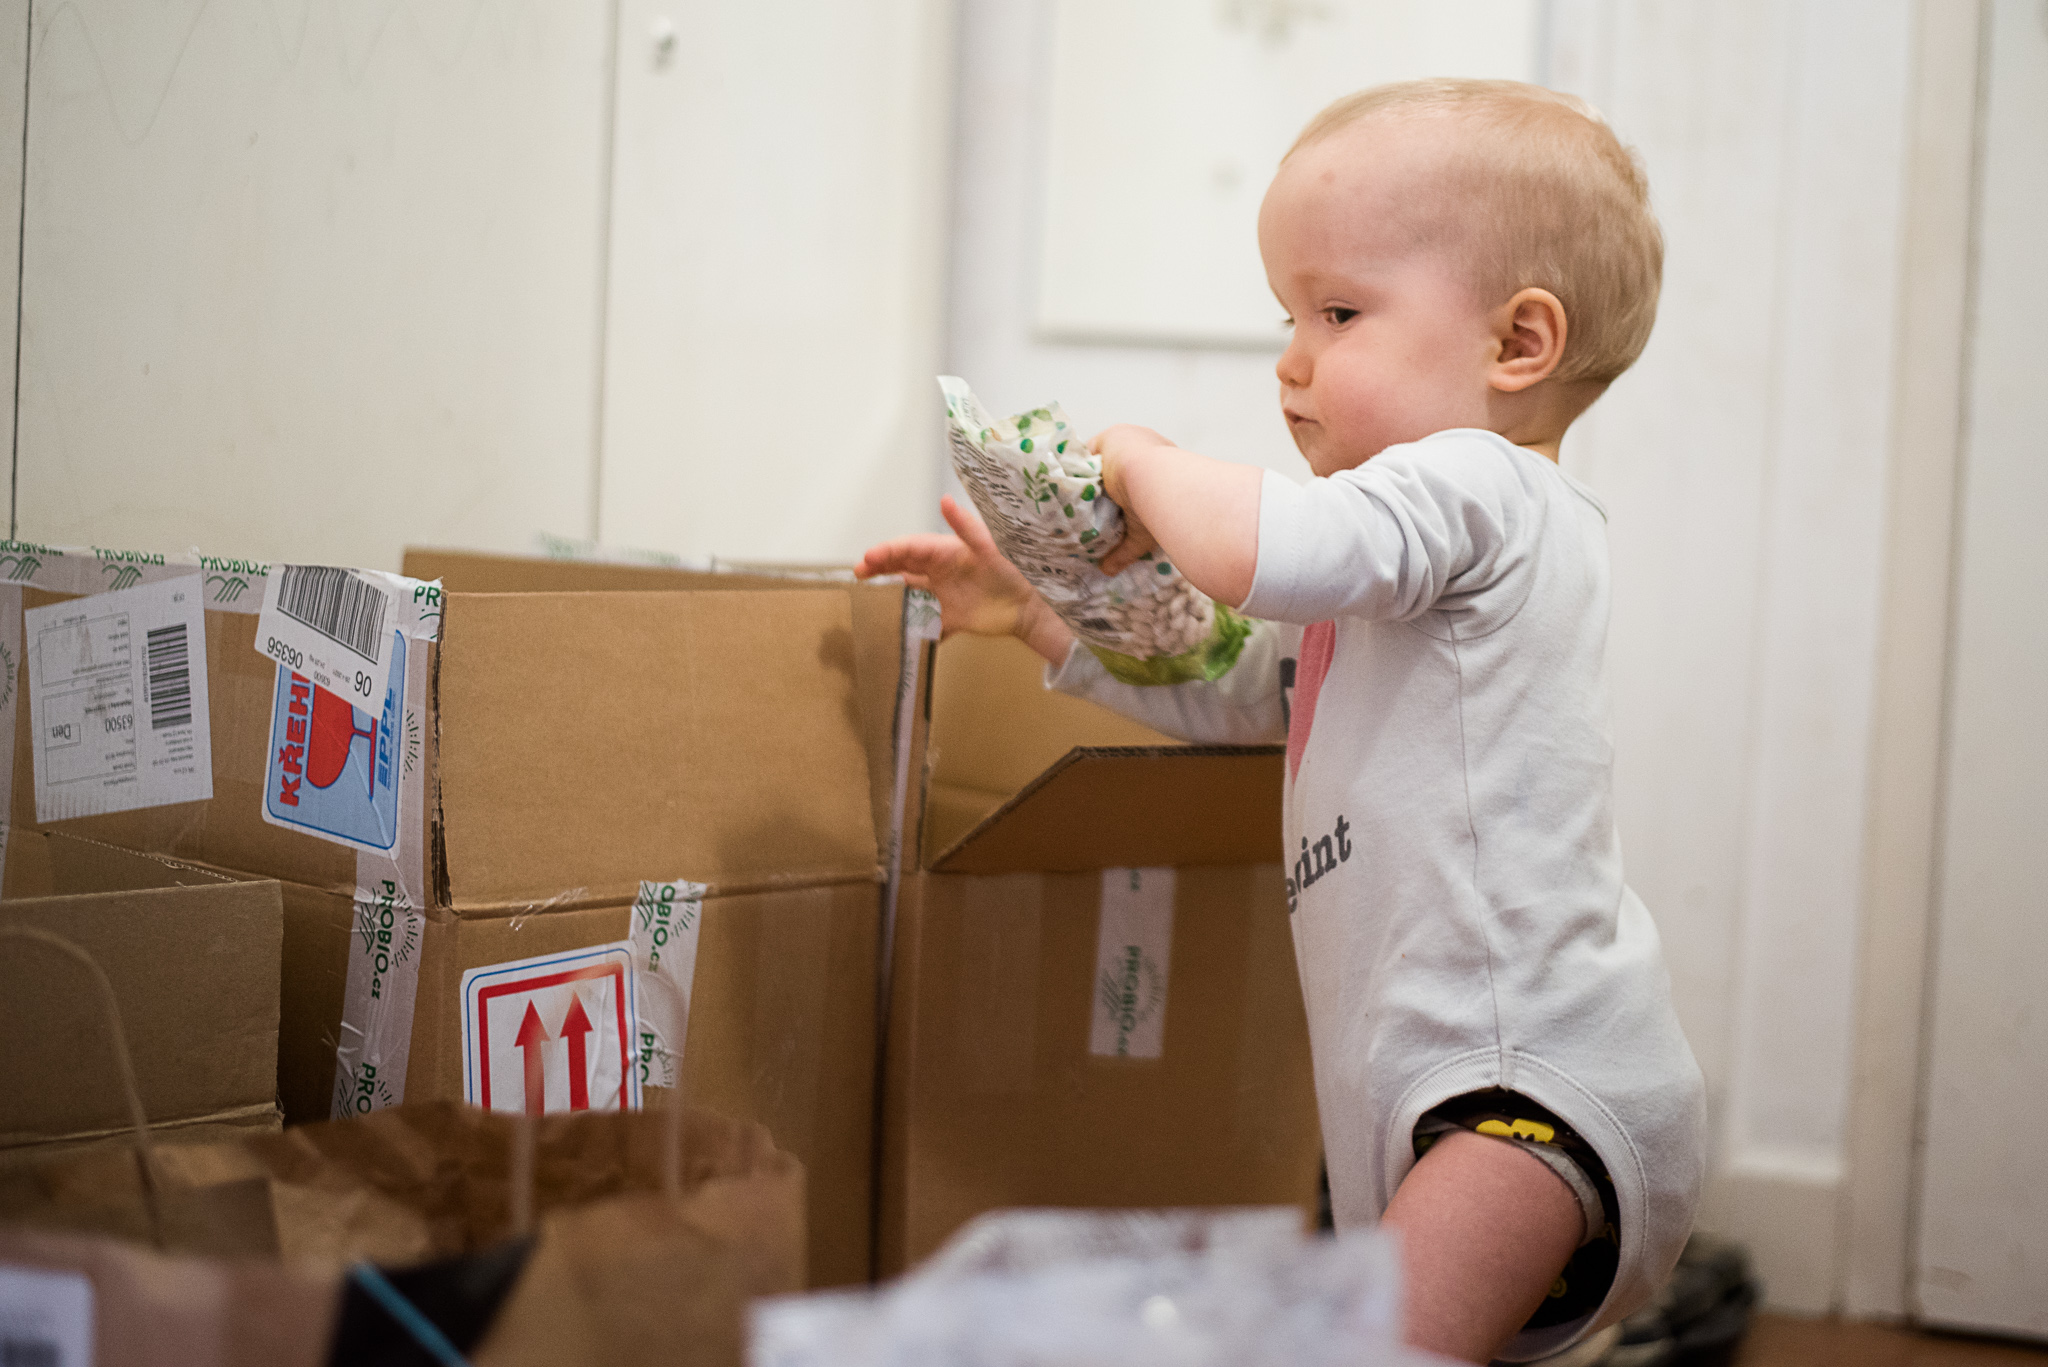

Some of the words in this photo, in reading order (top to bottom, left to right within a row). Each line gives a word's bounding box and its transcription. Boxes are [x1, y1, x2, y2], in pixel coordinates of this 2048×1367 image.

[266, 636, 304, 669] 06356
[354, 670, 372, 697] 06
[52, 723, 72, 741] Den
[370, 879, 396, 1000] PROBIO.cz
[356, 1061, 377, 1114] PRO
